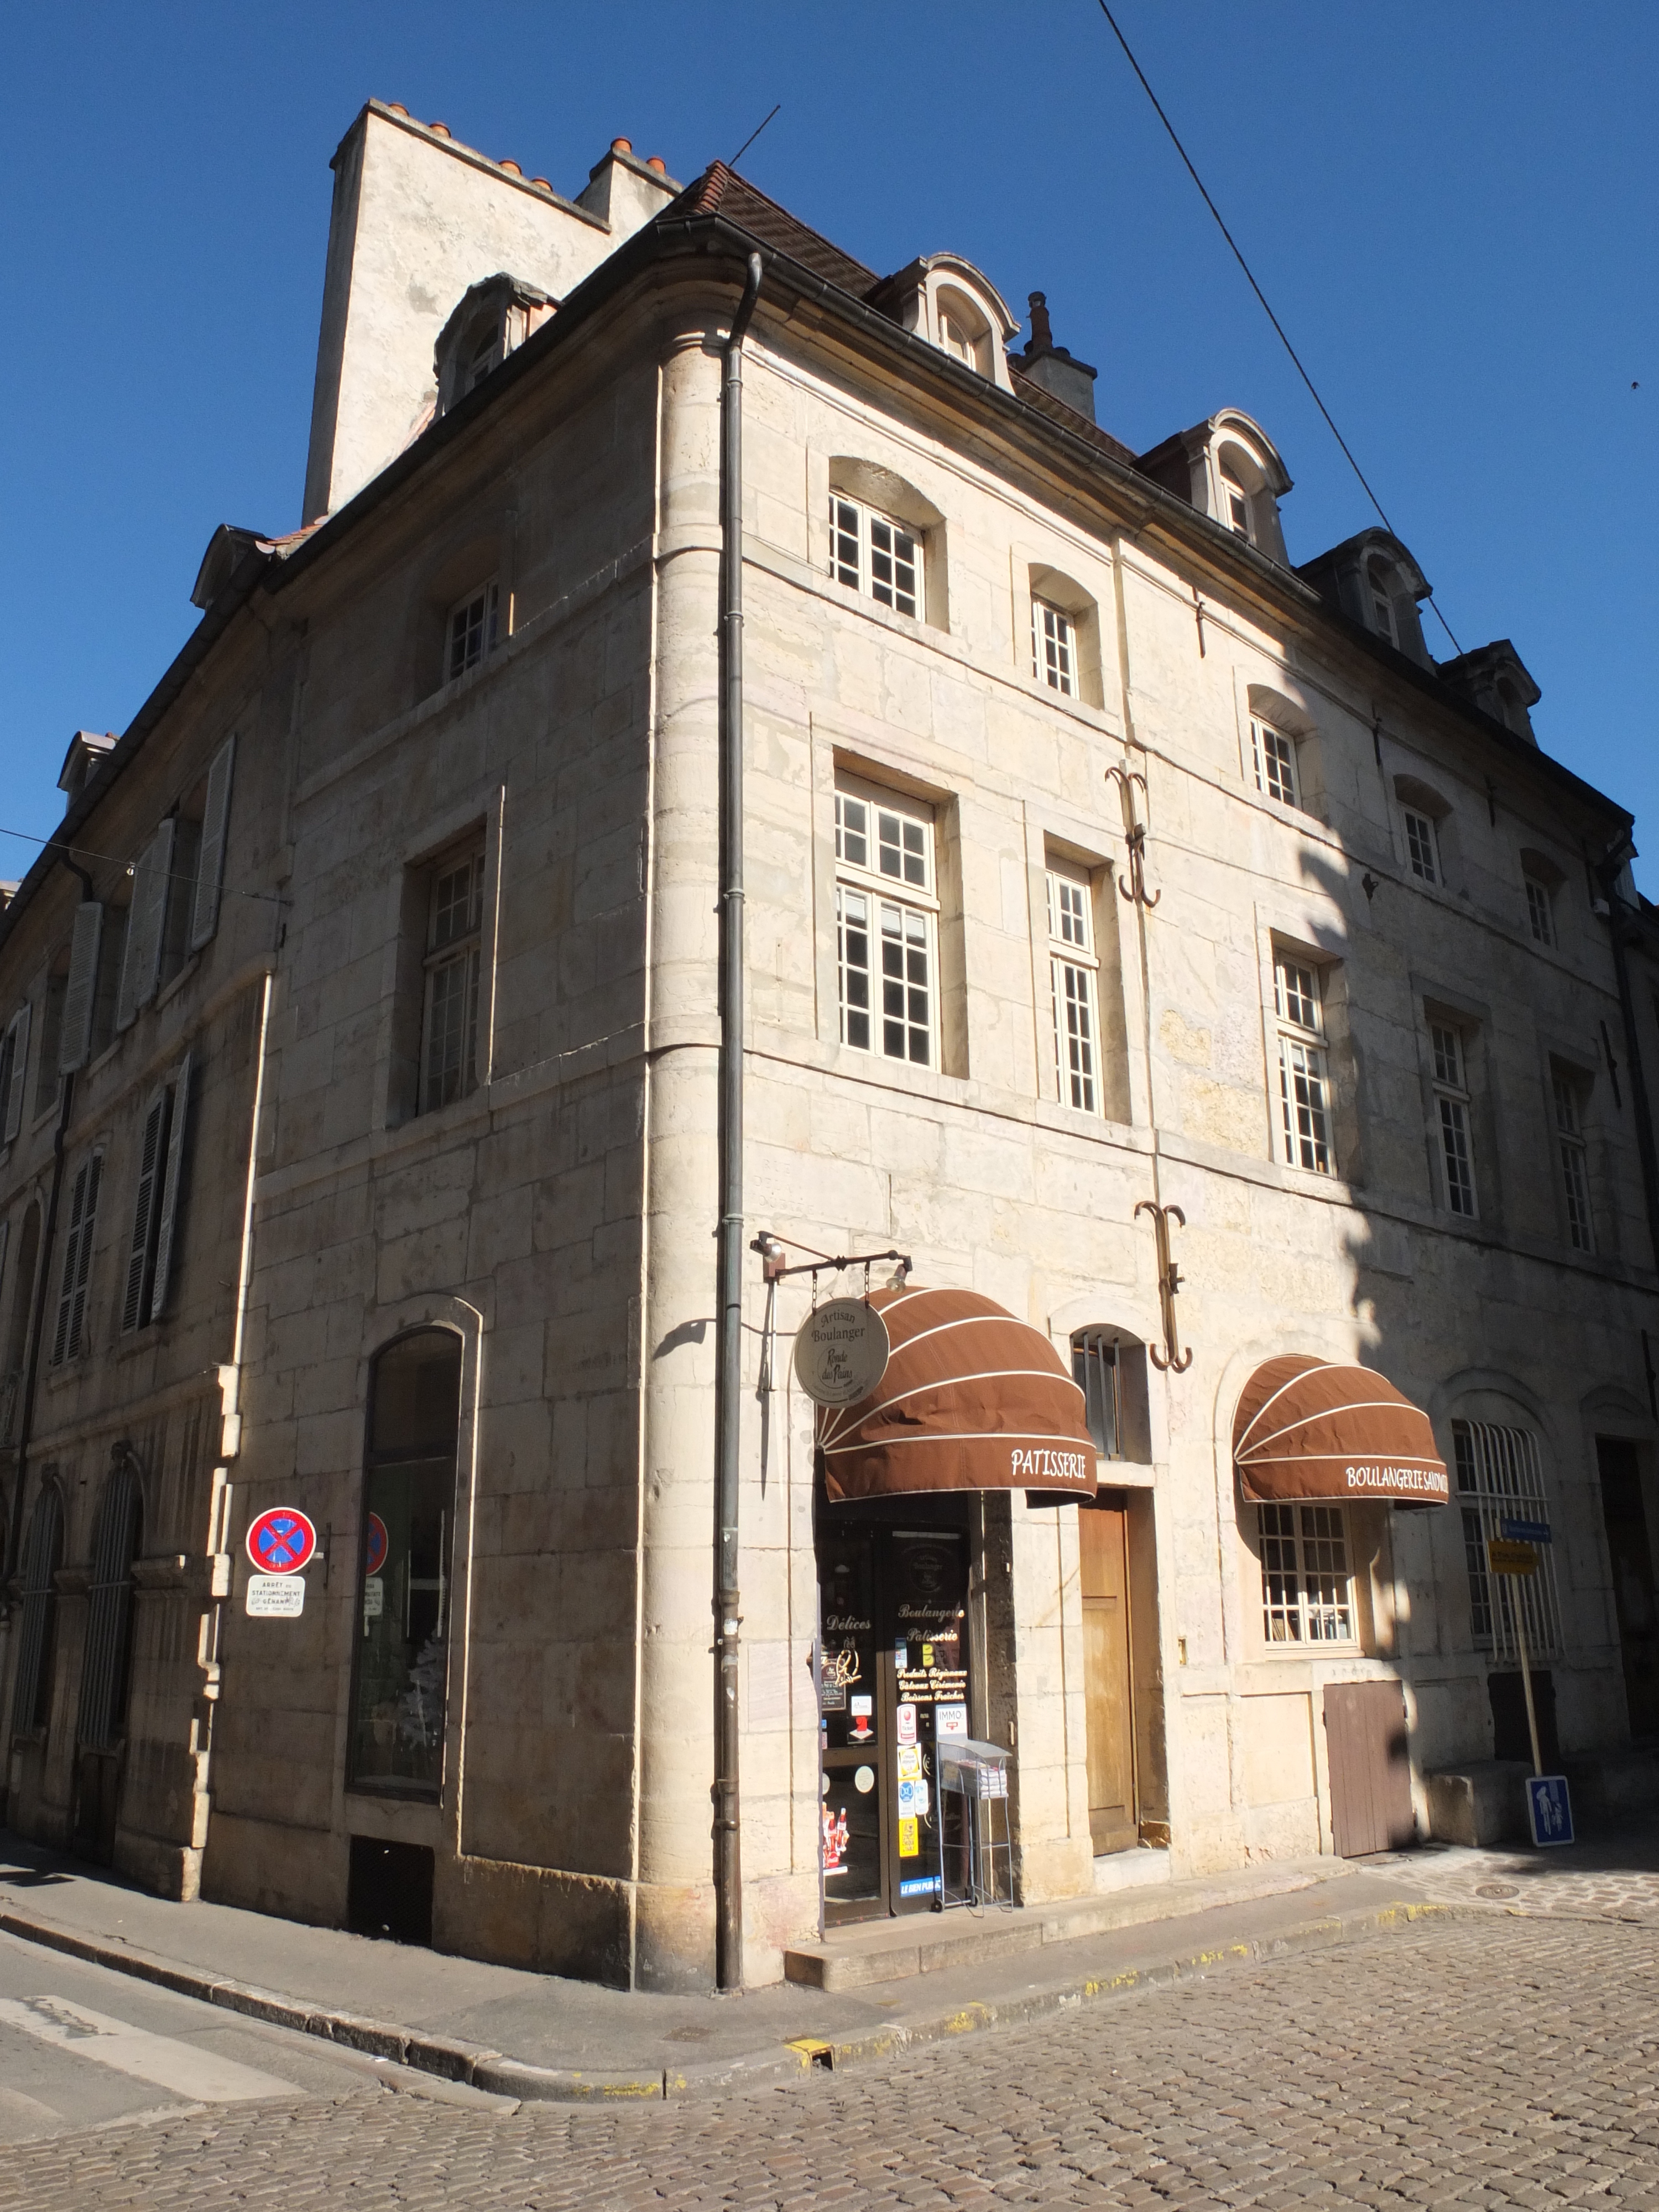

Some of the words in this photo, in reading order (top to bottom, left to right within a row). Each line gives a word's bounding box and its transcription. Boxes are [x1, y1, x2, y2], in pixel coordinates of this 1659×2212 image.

[821, 1309, 855, 1328] Artisan
[811, 1327, 865, 1342] Boulanger
[827, 1348, 848, 1367] Ronde
[822, 1368, 833, 1380] des
[832, 1364, 853, 1384] Pains
[1011, 1448, 1086, 1479] PATISSERIE
[1345, 1465, 1423, 1490] BOULANGERIE
[898, 1603, 966, 1623] Boulangerie
[826, 1614, 872, 1631] Délices
[897, 1667, 927, 1679] Produits
[900, 1691, 933, 1702] Boissons
[939, 1710, 962, 1721] IMMO
[901, 1885, 909, 1894] LE
[908, 1882, 922, 1893] BIEN
